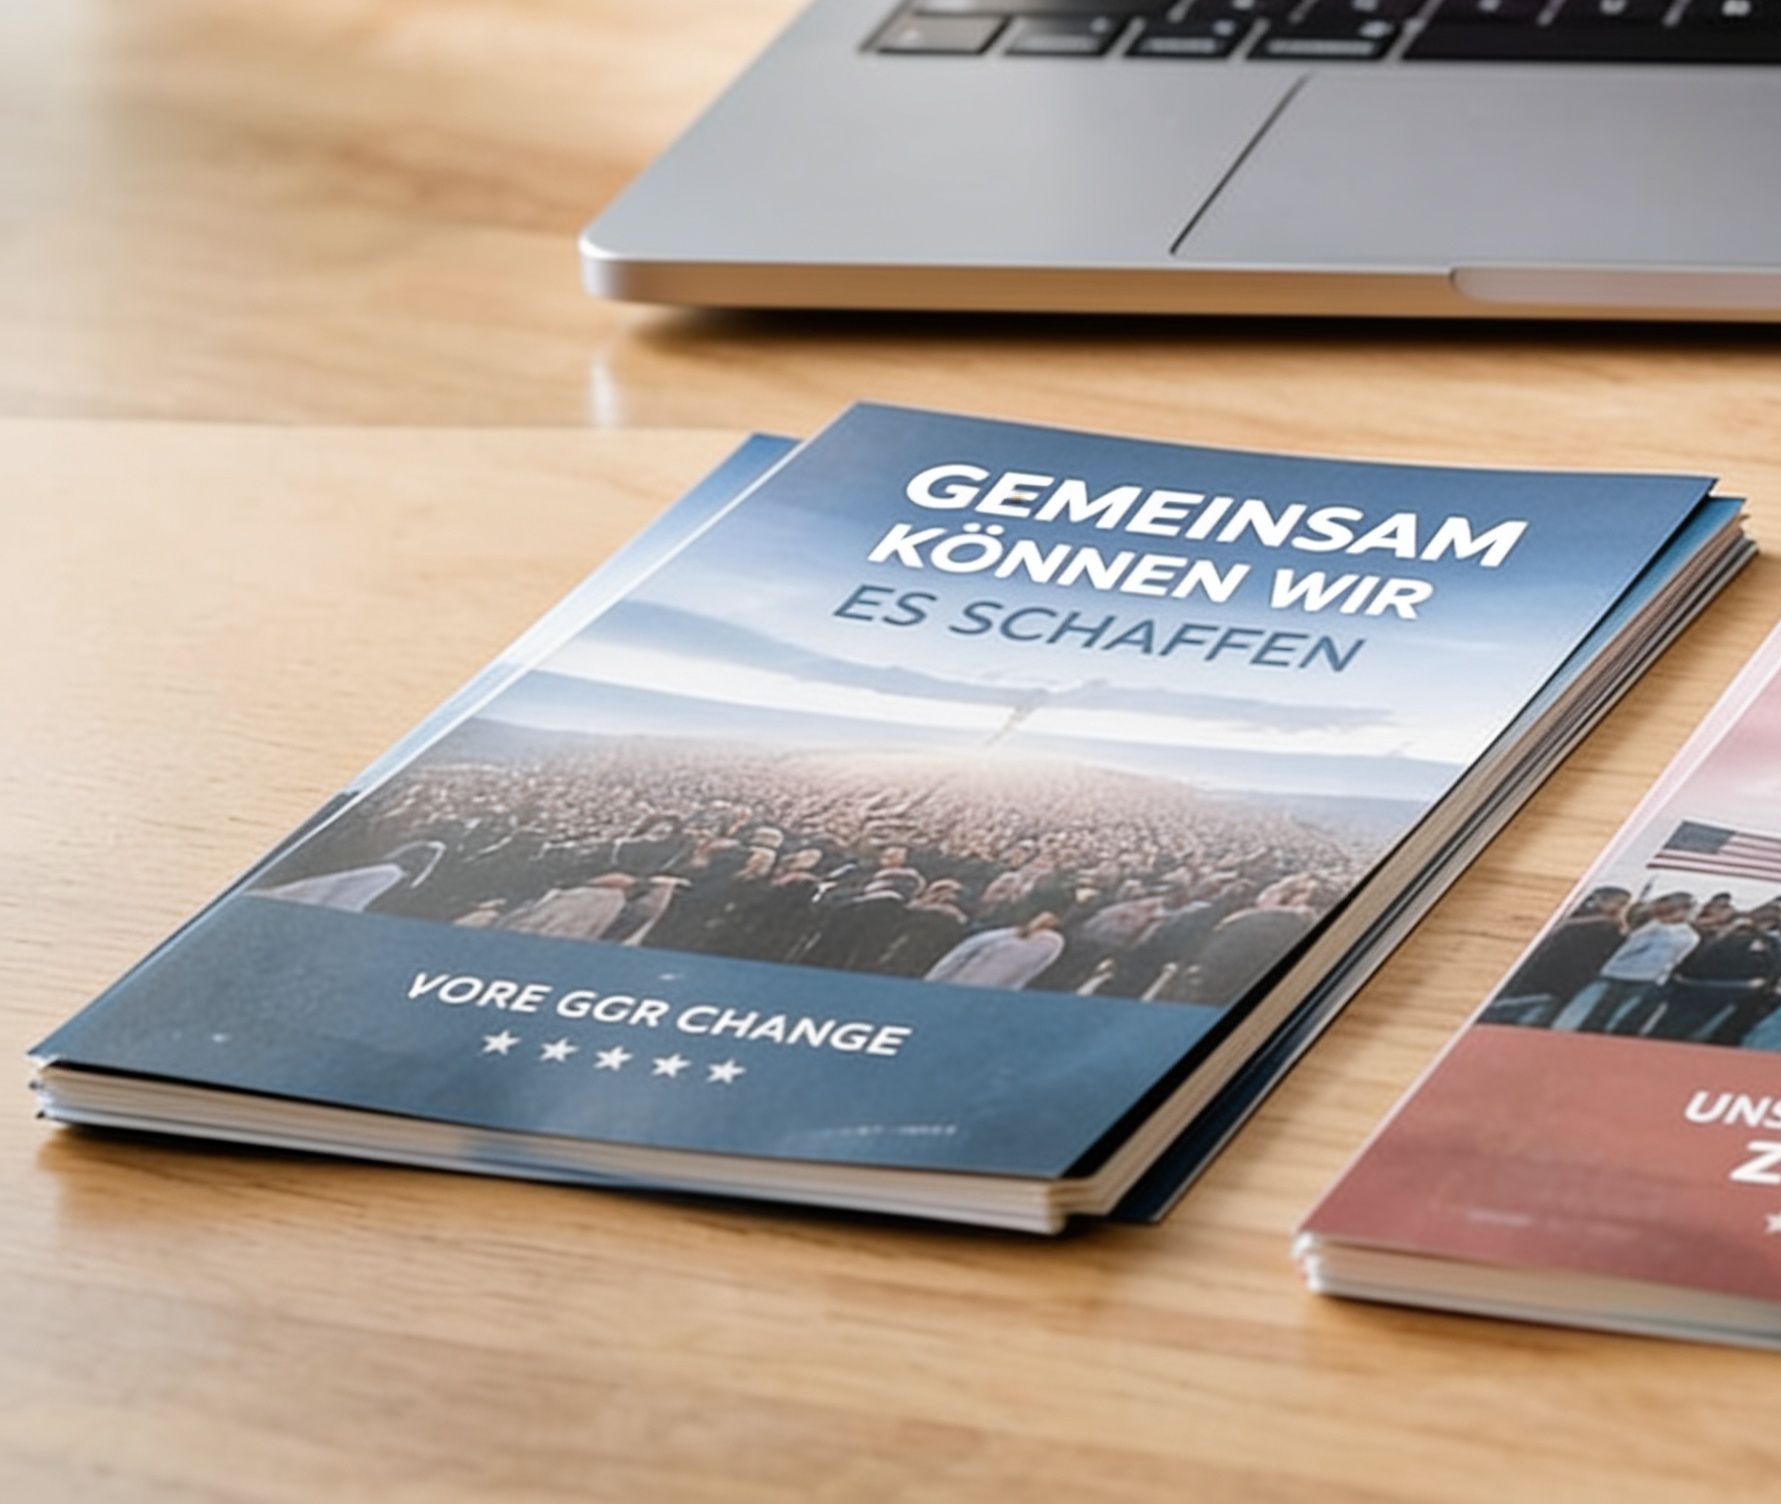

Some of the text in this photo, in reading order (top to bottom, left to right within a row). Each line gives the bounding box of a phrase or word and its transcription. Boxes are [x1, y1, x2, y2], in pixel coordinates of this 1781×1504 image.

[904, 462, 1528, 568] GEMEINSAM
[867, 522, 1436, 620] KÖNNEN WIR
[832, 584, 1366, 674] ES SCHAFFEN
[407, 972, 553, 1014] VORE
[676, 1004, 913, 1057] CHANGE
